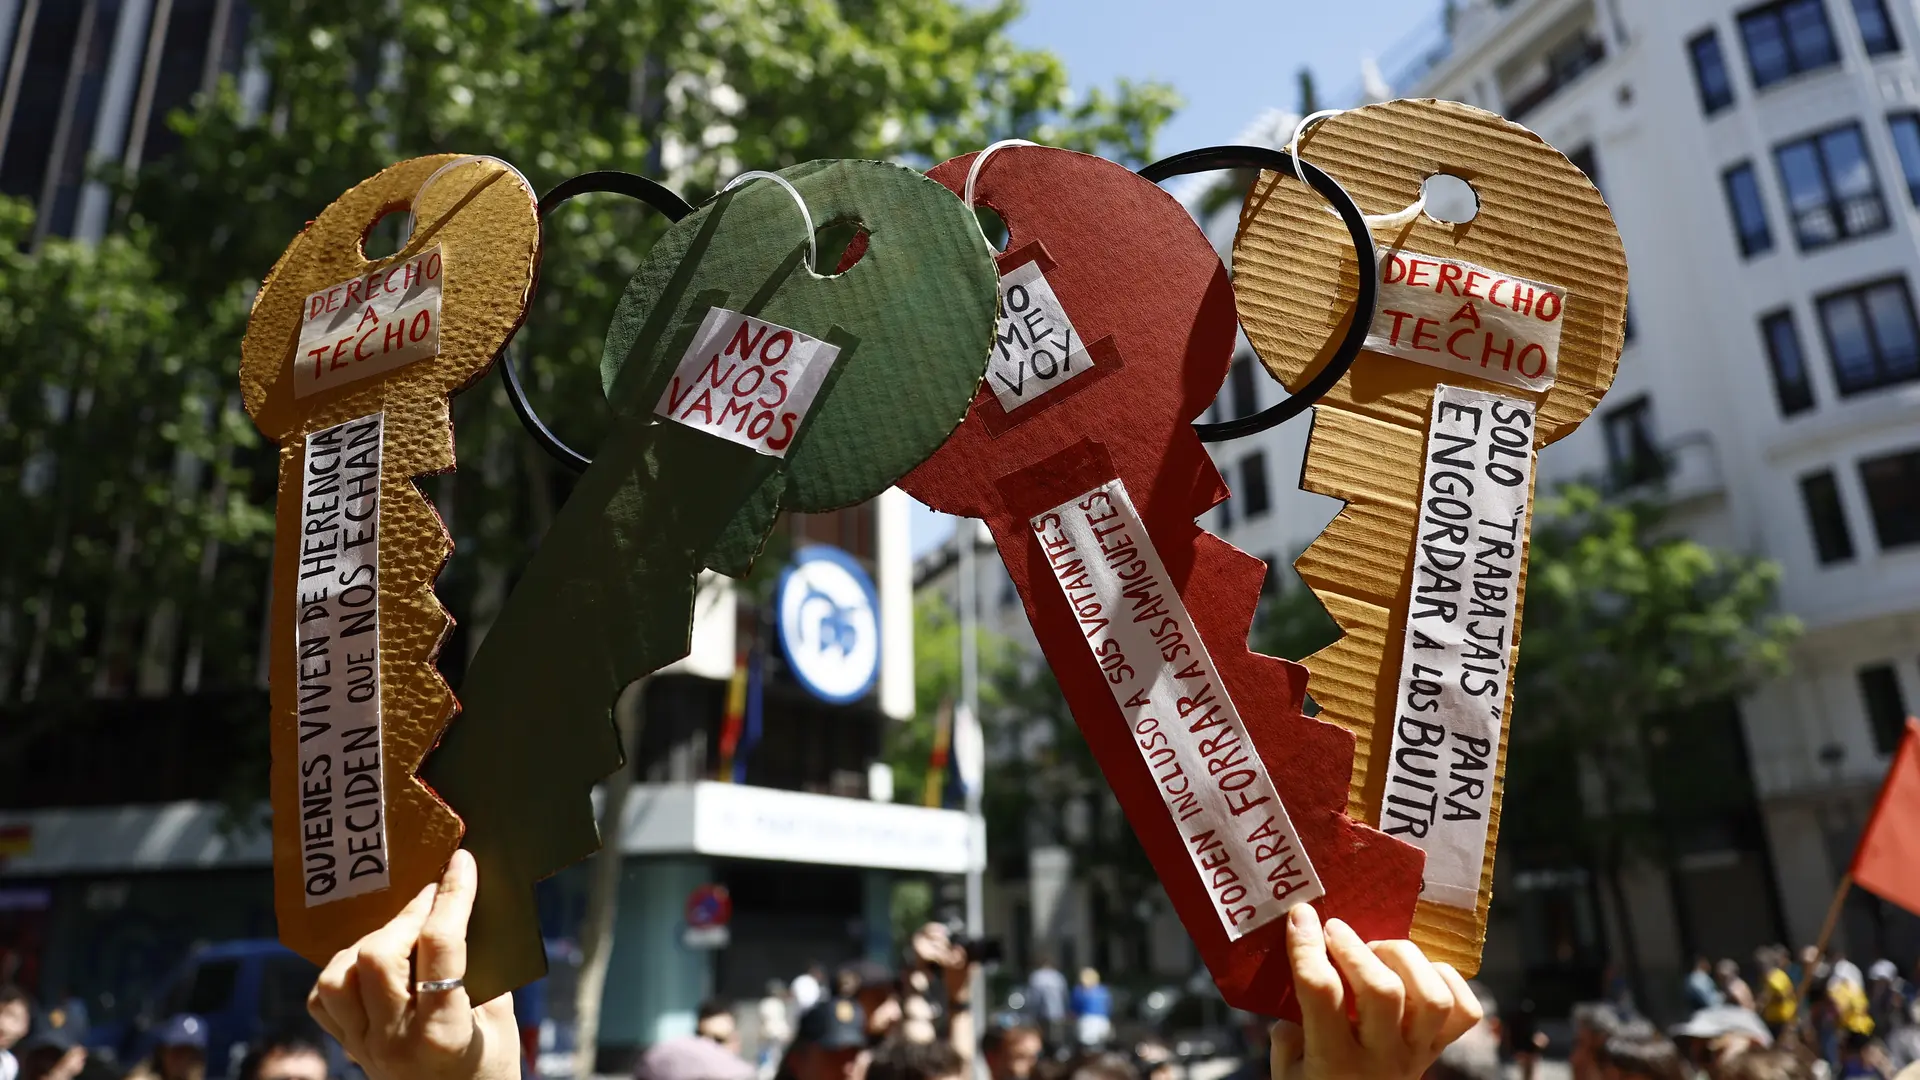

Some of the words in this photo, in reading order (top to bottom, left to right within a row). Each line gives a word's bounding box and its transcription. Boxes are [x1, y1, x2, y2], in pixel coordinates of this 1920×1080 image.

[310, 253, 441, 320] DERECHO
[357, 305, 379, 332] A
[1383, 254, 1562, 322] DERECHO
[1450, 301, 1481, 329] A
[308, 310, 430, 380] TECHO
[725, 320, 793, 366] NO
[995, 329, 1070, 396] VOY
[997, 308, 1053, 361] ME
[1383, 309, 1548, 379] TECHO
[667, 376, 797, 450] VAMOS
[696, 353, 788, 409] NOS
[1485, 400, 1531, 487] SOLO
[301, 425, 343, 580] HERENCIA
[344, 420, 380, 551] ECHAN
[1411, 401, 1483, 623] ENGORDAR
[1032, 513, 1109, 638] VOTANTES
[1079, 491, 1170, 624] AMIGUETES
[301, 587, 330, 624] DE
[338, 564, 376, 638] NOS
[1095, 638, 1135, 685] SUS
[1150, 617, 1190, 663] SUS
[1174, 660, 1205, 680] A
[1412, 630, 1445, 650] A
[300, 636, 331, 743] VIVEN
[347, 648, 375, 703] QUE
[1124, 688, 1150, 708] A
[1407, 663, 1444, 713] LOS
[1136, 718, 1204, 822] INCLUSO
[1176, 683, 1271, 817] FORRAR
[1383, 715, 1445, 840] BUITR
[1442, 732, 1491, 821] PARA
[302, 753, 337, 896] QUIENES
[341, 725, 385, 882] DECIDEN
[1190, 829, 1256, 926] JODEN
[1246, 815, 1309, 901] PARA
